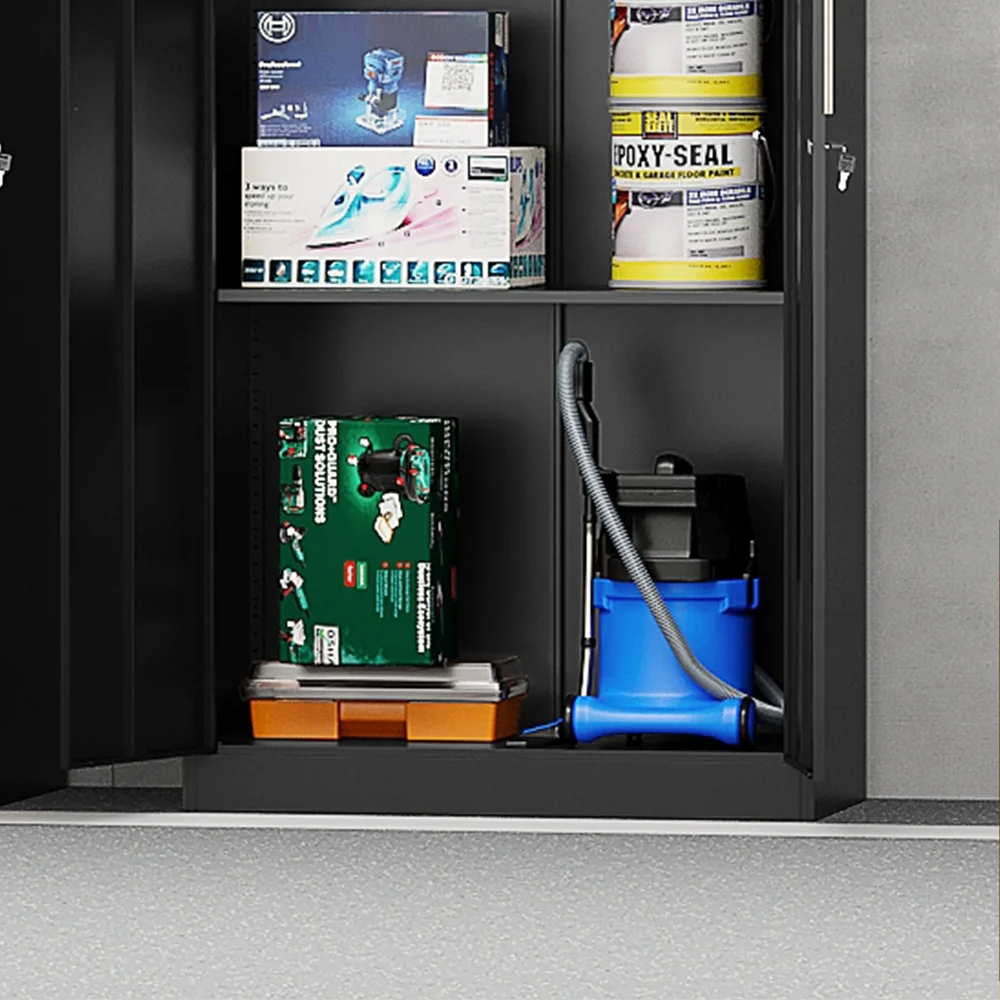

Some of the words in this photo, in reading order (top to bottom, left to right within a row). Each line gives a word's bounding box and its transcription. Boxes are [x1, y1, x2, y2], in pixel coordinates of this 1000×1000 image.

[643, 170, 675, 179] GARAGE
[678, 170, 706, 179] FLOOR
[708, 168, 734, 177] PAINT
[253, 184, 275, 192] ways
[314, 420, 326, 452] DUST
[314, 453, 326, 524] SOLUTIONS
